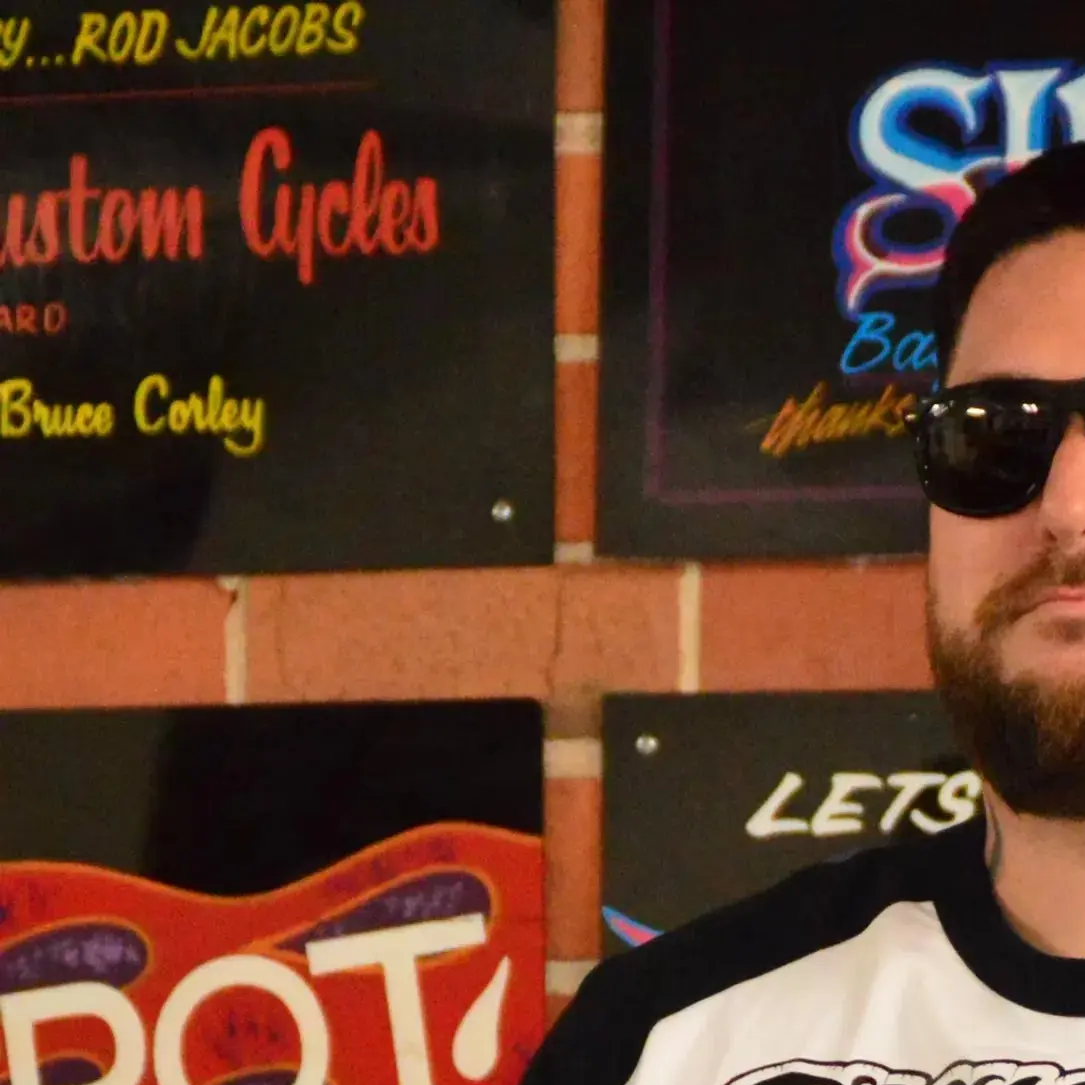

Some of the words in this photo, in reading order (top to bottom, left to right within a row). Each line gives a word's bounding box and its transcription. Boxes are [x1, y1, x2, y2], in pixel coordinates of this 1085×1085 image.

[176, 2, 363, 62] JACOBS
[240, 125, 440, 285] Cycles
[840, 311, 940, 375] Ba
[0, 377, 114, 438] Bruce
[134, 373, 265, 456] Corley
[745, 770, 985, 837] LETS
